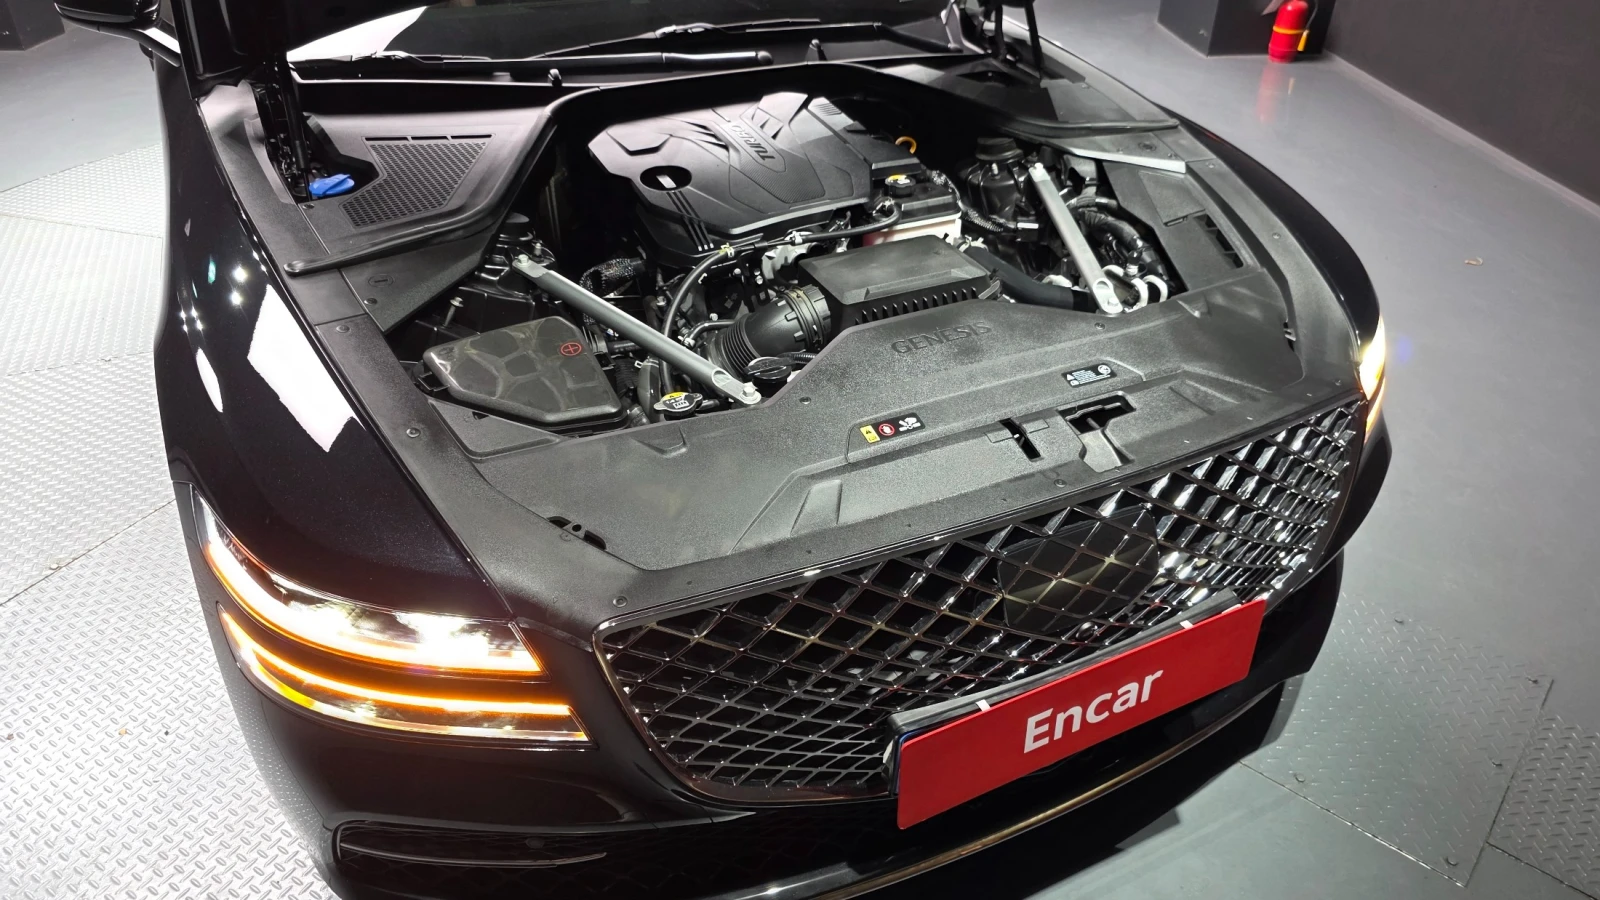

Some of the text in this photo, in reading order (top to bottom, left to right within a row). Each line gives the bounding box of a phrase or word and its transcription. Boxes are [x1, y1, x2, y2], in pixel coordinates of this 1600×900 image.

[730, 125, 776, 161] TURBO
[890, 320, 993, 354] GENESIS
[1023, 669, 1164, 754] Encar
